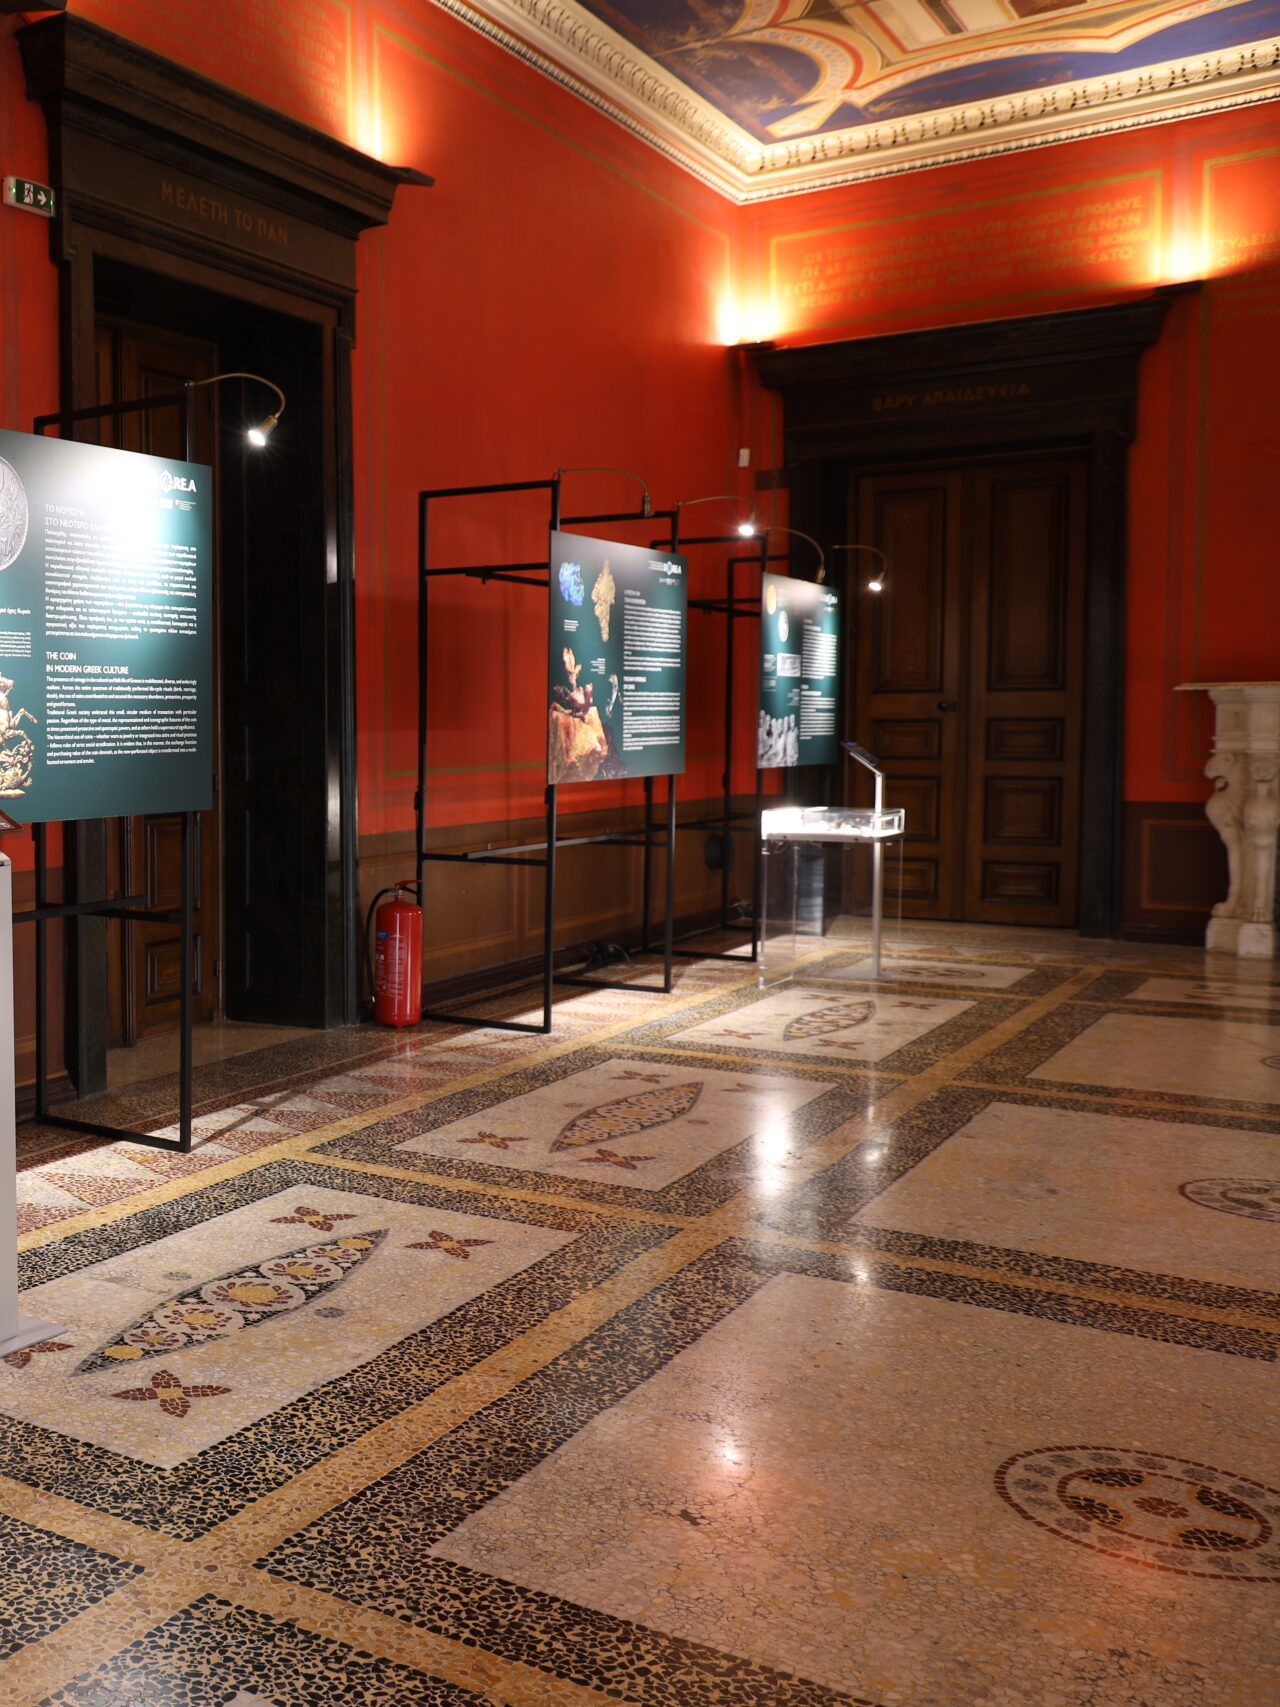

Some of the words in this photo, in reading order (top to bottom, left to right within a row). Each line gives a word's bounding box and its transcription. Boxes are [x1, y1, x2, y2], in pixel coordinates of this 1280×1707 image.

[161, 179, 228, 224] ΜΕΛΕΤΗ
[234, 209, 254, 232] ΤΟ
[46, 651, 59, 660] THE
[59, 651, 77, 661] COIN
[46, 664, 53, 673] IN
[54, 664, 82, 674] MODERN
[82, 665, 103, 674] GREEK
[103, 666, 129, 675] CULTURE
